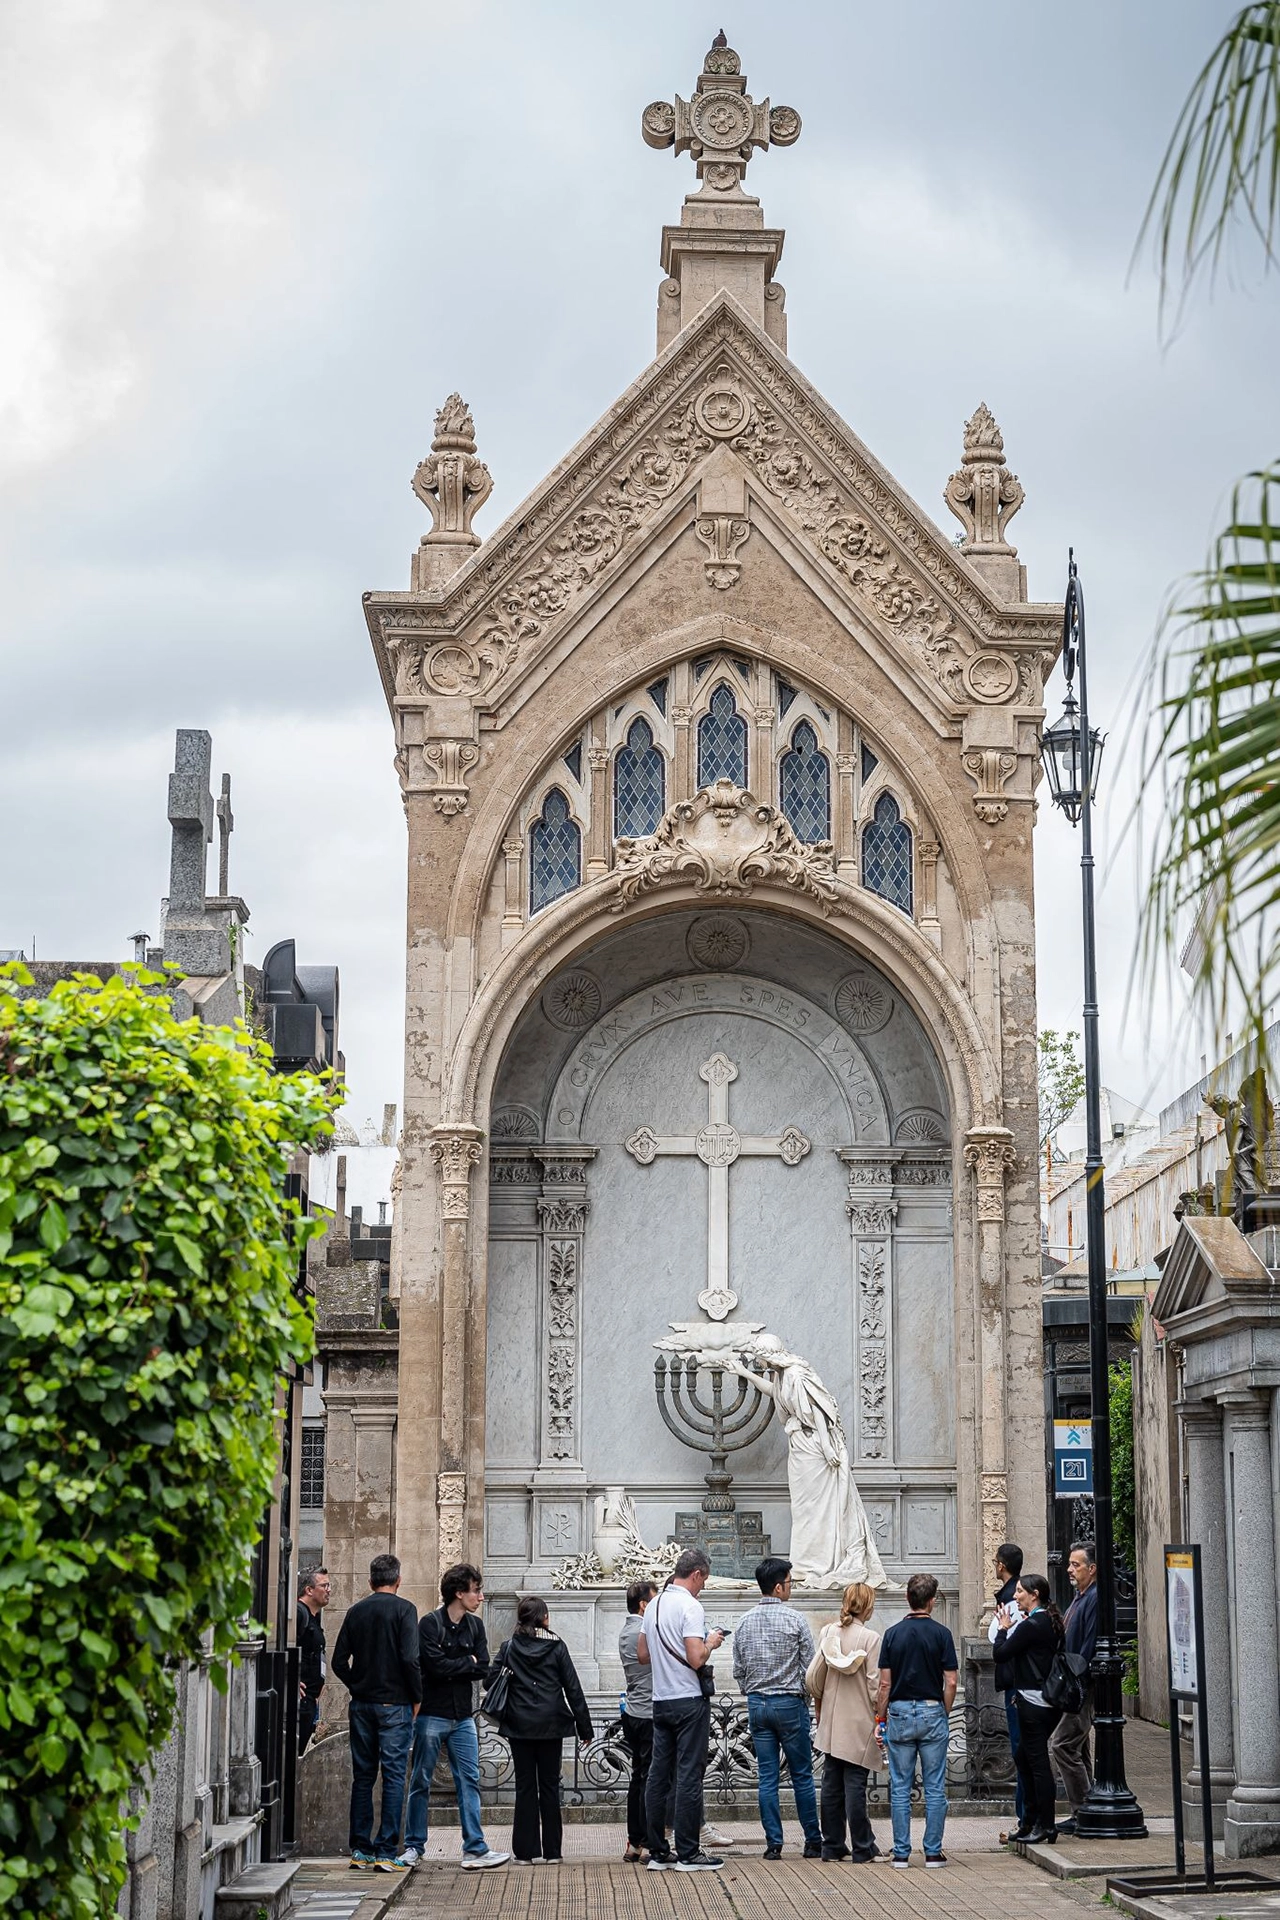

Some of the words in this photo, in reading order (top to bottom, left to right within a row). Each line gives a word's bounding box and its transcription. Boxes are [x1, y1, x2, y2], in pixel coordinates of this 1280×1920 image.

[558, 1108, 574, 1125] O
[570, 1018, 631, 1087] CRVX
[651, 983, 708, 1016] AVE
[740, 985, 811, 1028] SPES
[829, 1036, 878, 1132] VNICA
[1065, 1461, 1082, 1477] 21
